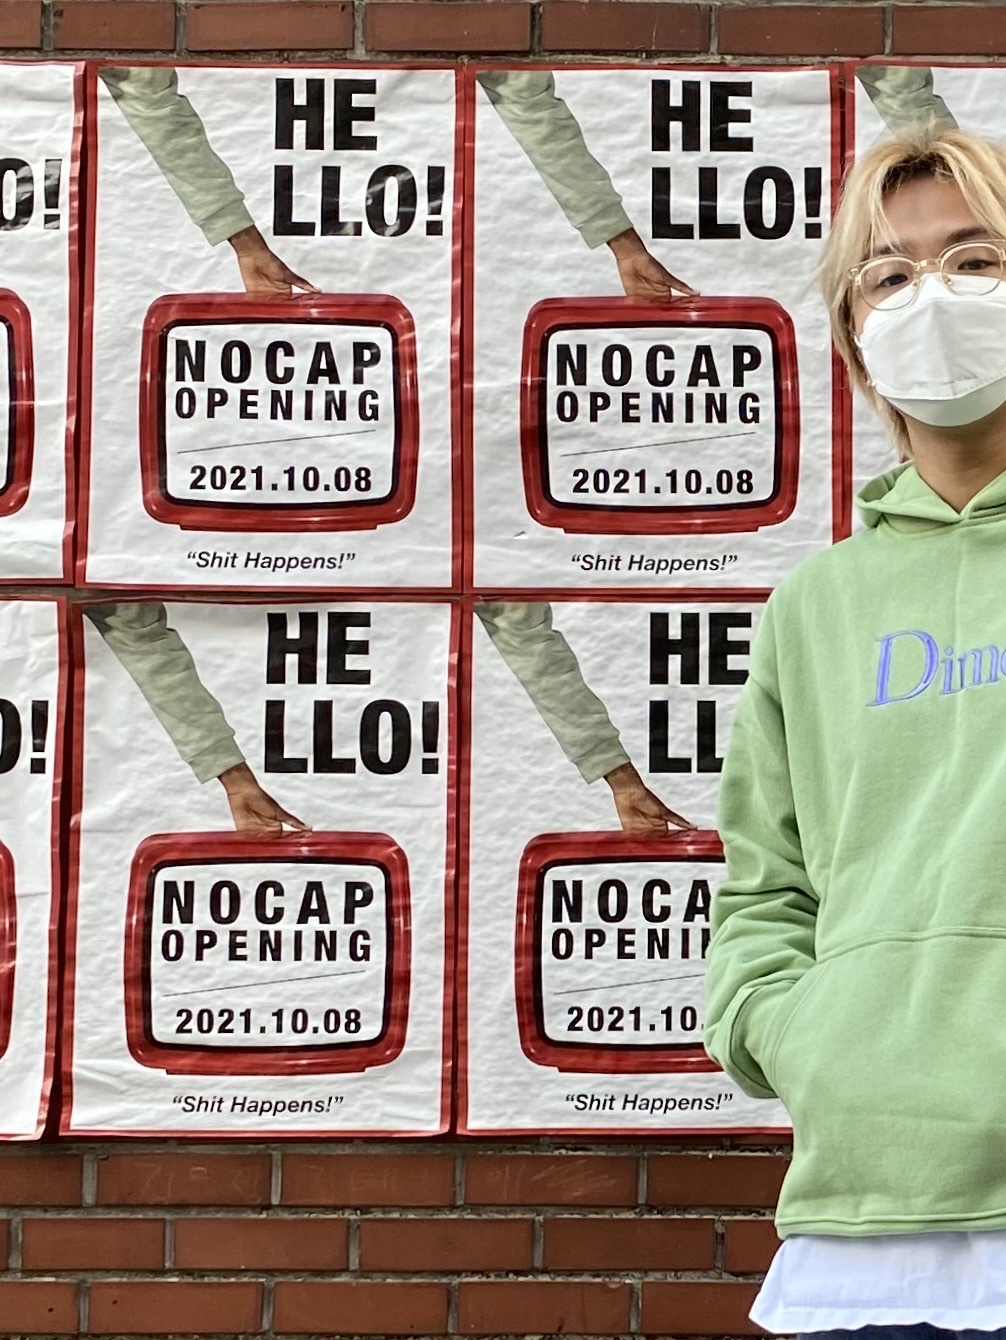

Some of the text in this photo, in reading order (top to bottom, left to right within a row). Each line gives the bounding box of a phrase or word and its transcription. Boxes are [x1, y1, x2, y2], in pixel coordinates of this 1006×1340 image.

[275, 78, 377, 150] HE
[652, 80, 753, 152] HE
[273, 165, 444, 237] LLO!
[652, 166, 821, 239] LLO!
[176, 340, 380, 384] NOCAP
[557, 344, 761, 387] NOCAP
[176, 388, 378, 421] OPENING
[557, 391, 759, 423] OPENING
[190, 466, 371, 491] 2021.10.08
[573, 469, 753, 494] 2021.10.08
[188, 552, 355, 572] “Shit Happens!”
[572, 555, 737, 574] “Shit Happens!”
[267, 612, 371, 684] HE
[650, 612, 752, 685] HE
[265, 700, 439, 774] LLO!
[649, 700, 724, 773] LL
[163, 881, 373, 924] NOCAP
[552, 879, 711, 923] NOCA
[162, 930, 370, 961] OPENING
[176, 1009, 360, 1033] 2021.10.08
[173, 1096, 343, 1116] “Shit Happens!”
[566, 1094, 732, 1114] “Shit Happens!”
